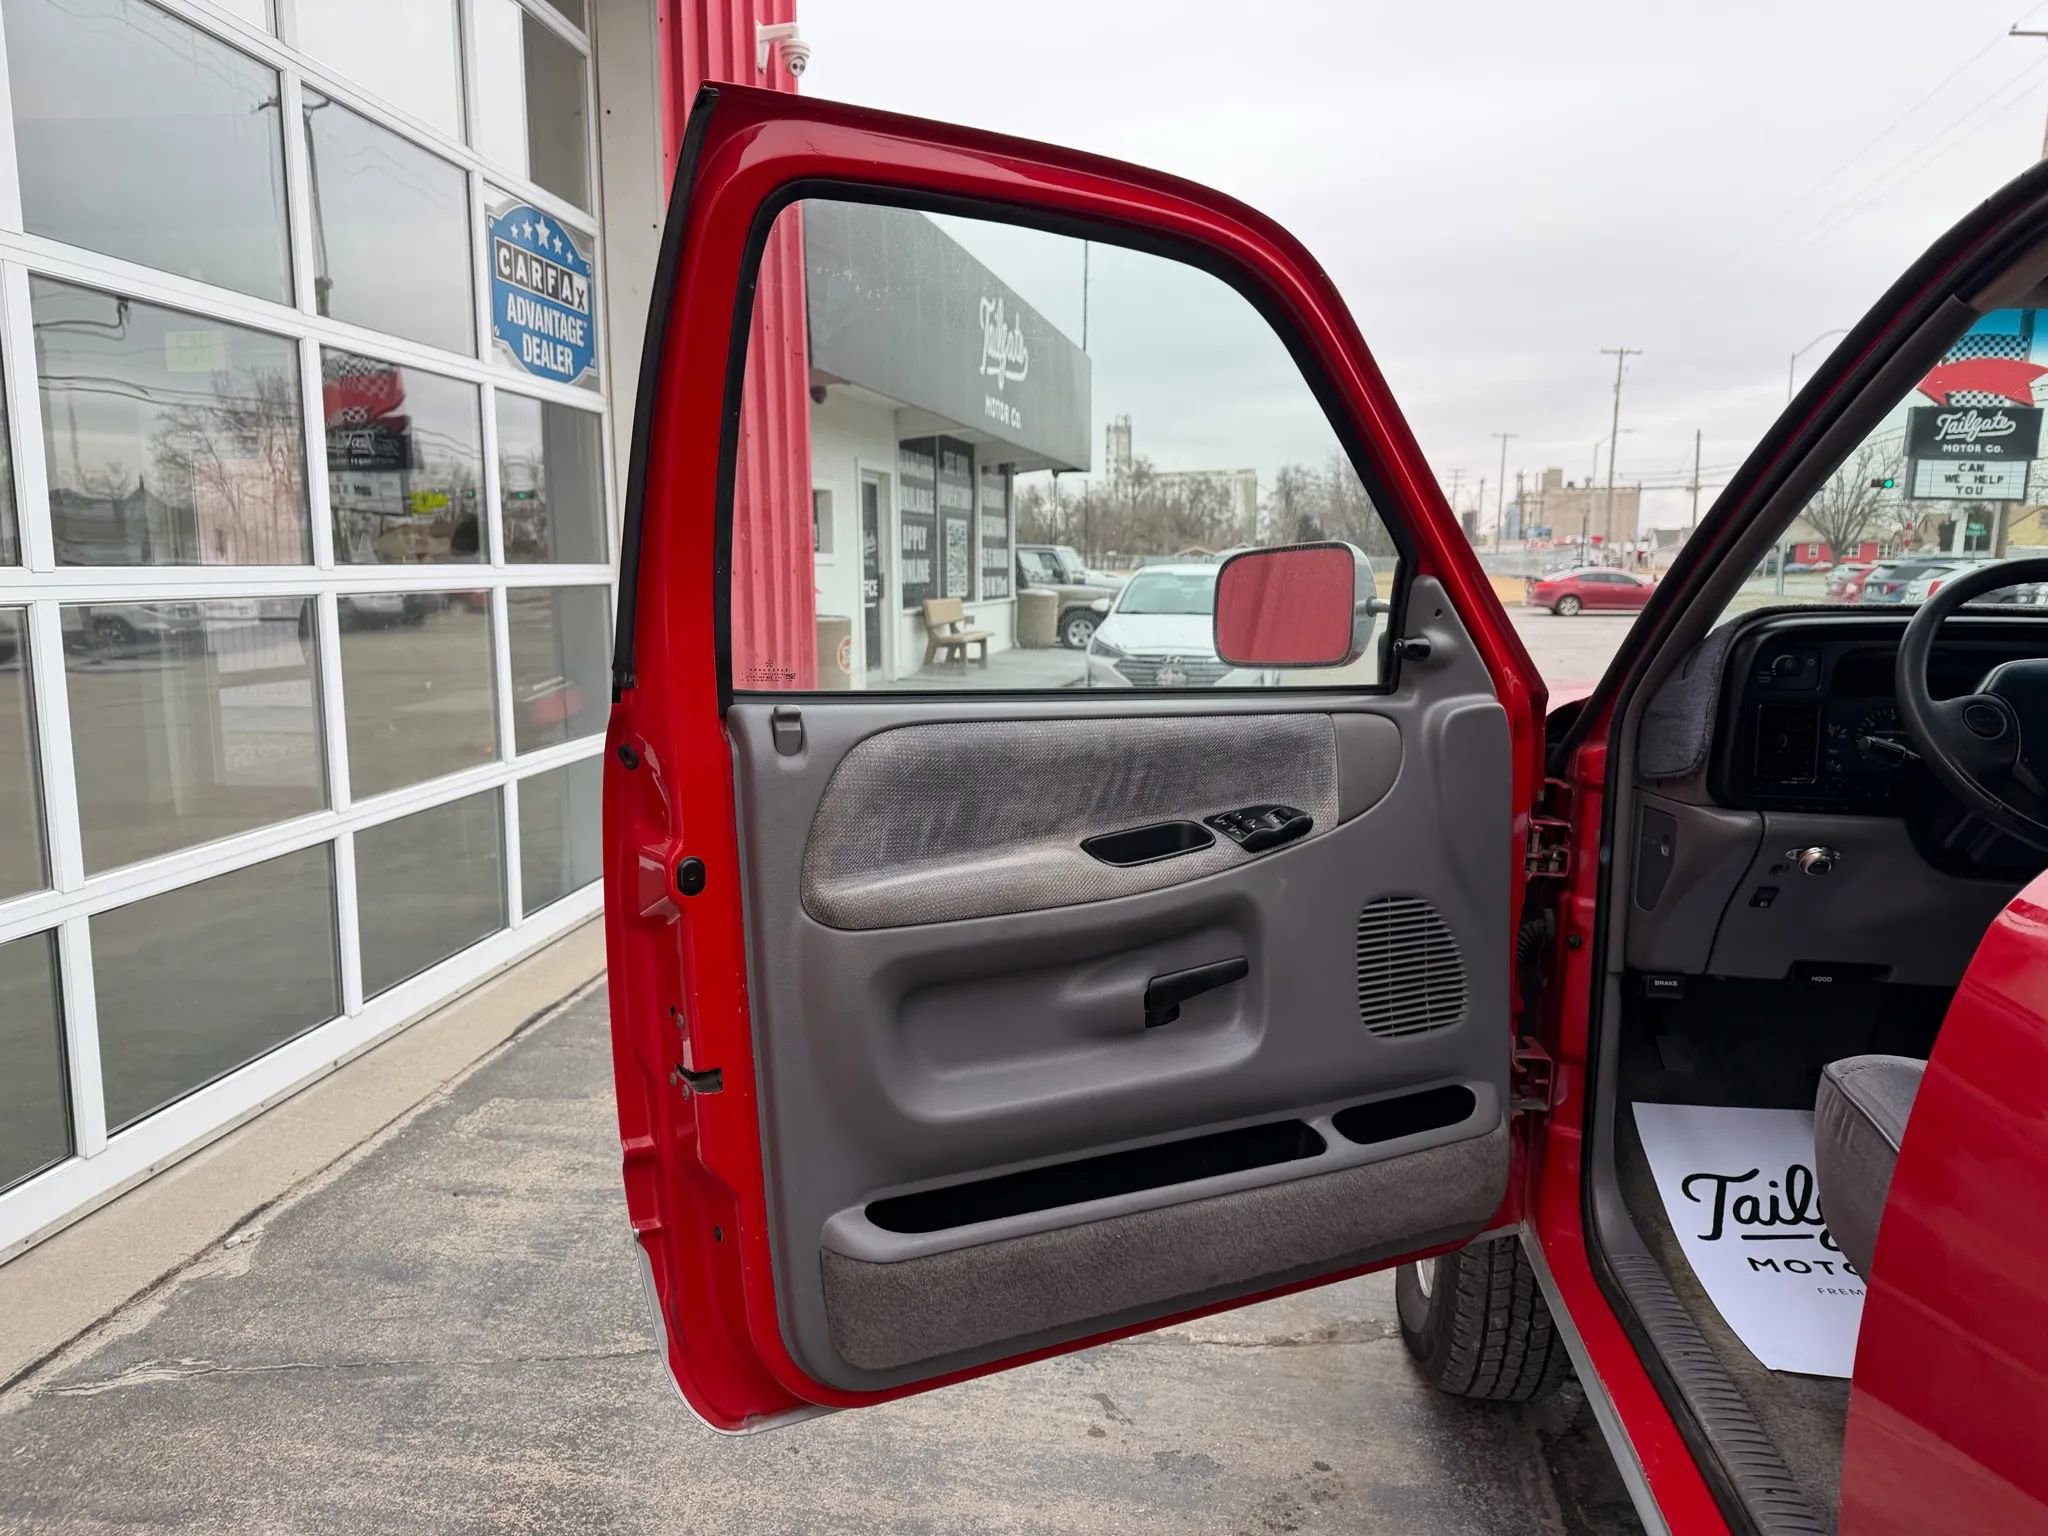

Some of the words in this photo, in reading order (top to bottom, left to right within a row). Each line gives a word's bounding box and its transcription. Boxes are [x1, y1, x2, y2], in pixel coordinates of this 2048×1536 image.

[499, 246, 586, 312] CARFAX
[506, 292, 586, 348] ADVANTAGE
[522, 332, 575, 377] DEALER
[985, 393, 1009, 424] MOTOR
[1934, 409, 2017, 442] Tailgate
[1942, 444, 1981, 453] MOTOR
[1958, 463, 1985, 473] CAN
[1944, 474, 1961, 484] WE
[1974, 475, 2004, 485] HELP
[1956, 485, 1984, 495] YOU
[1817, 1287, 1865, 1296] FREM
